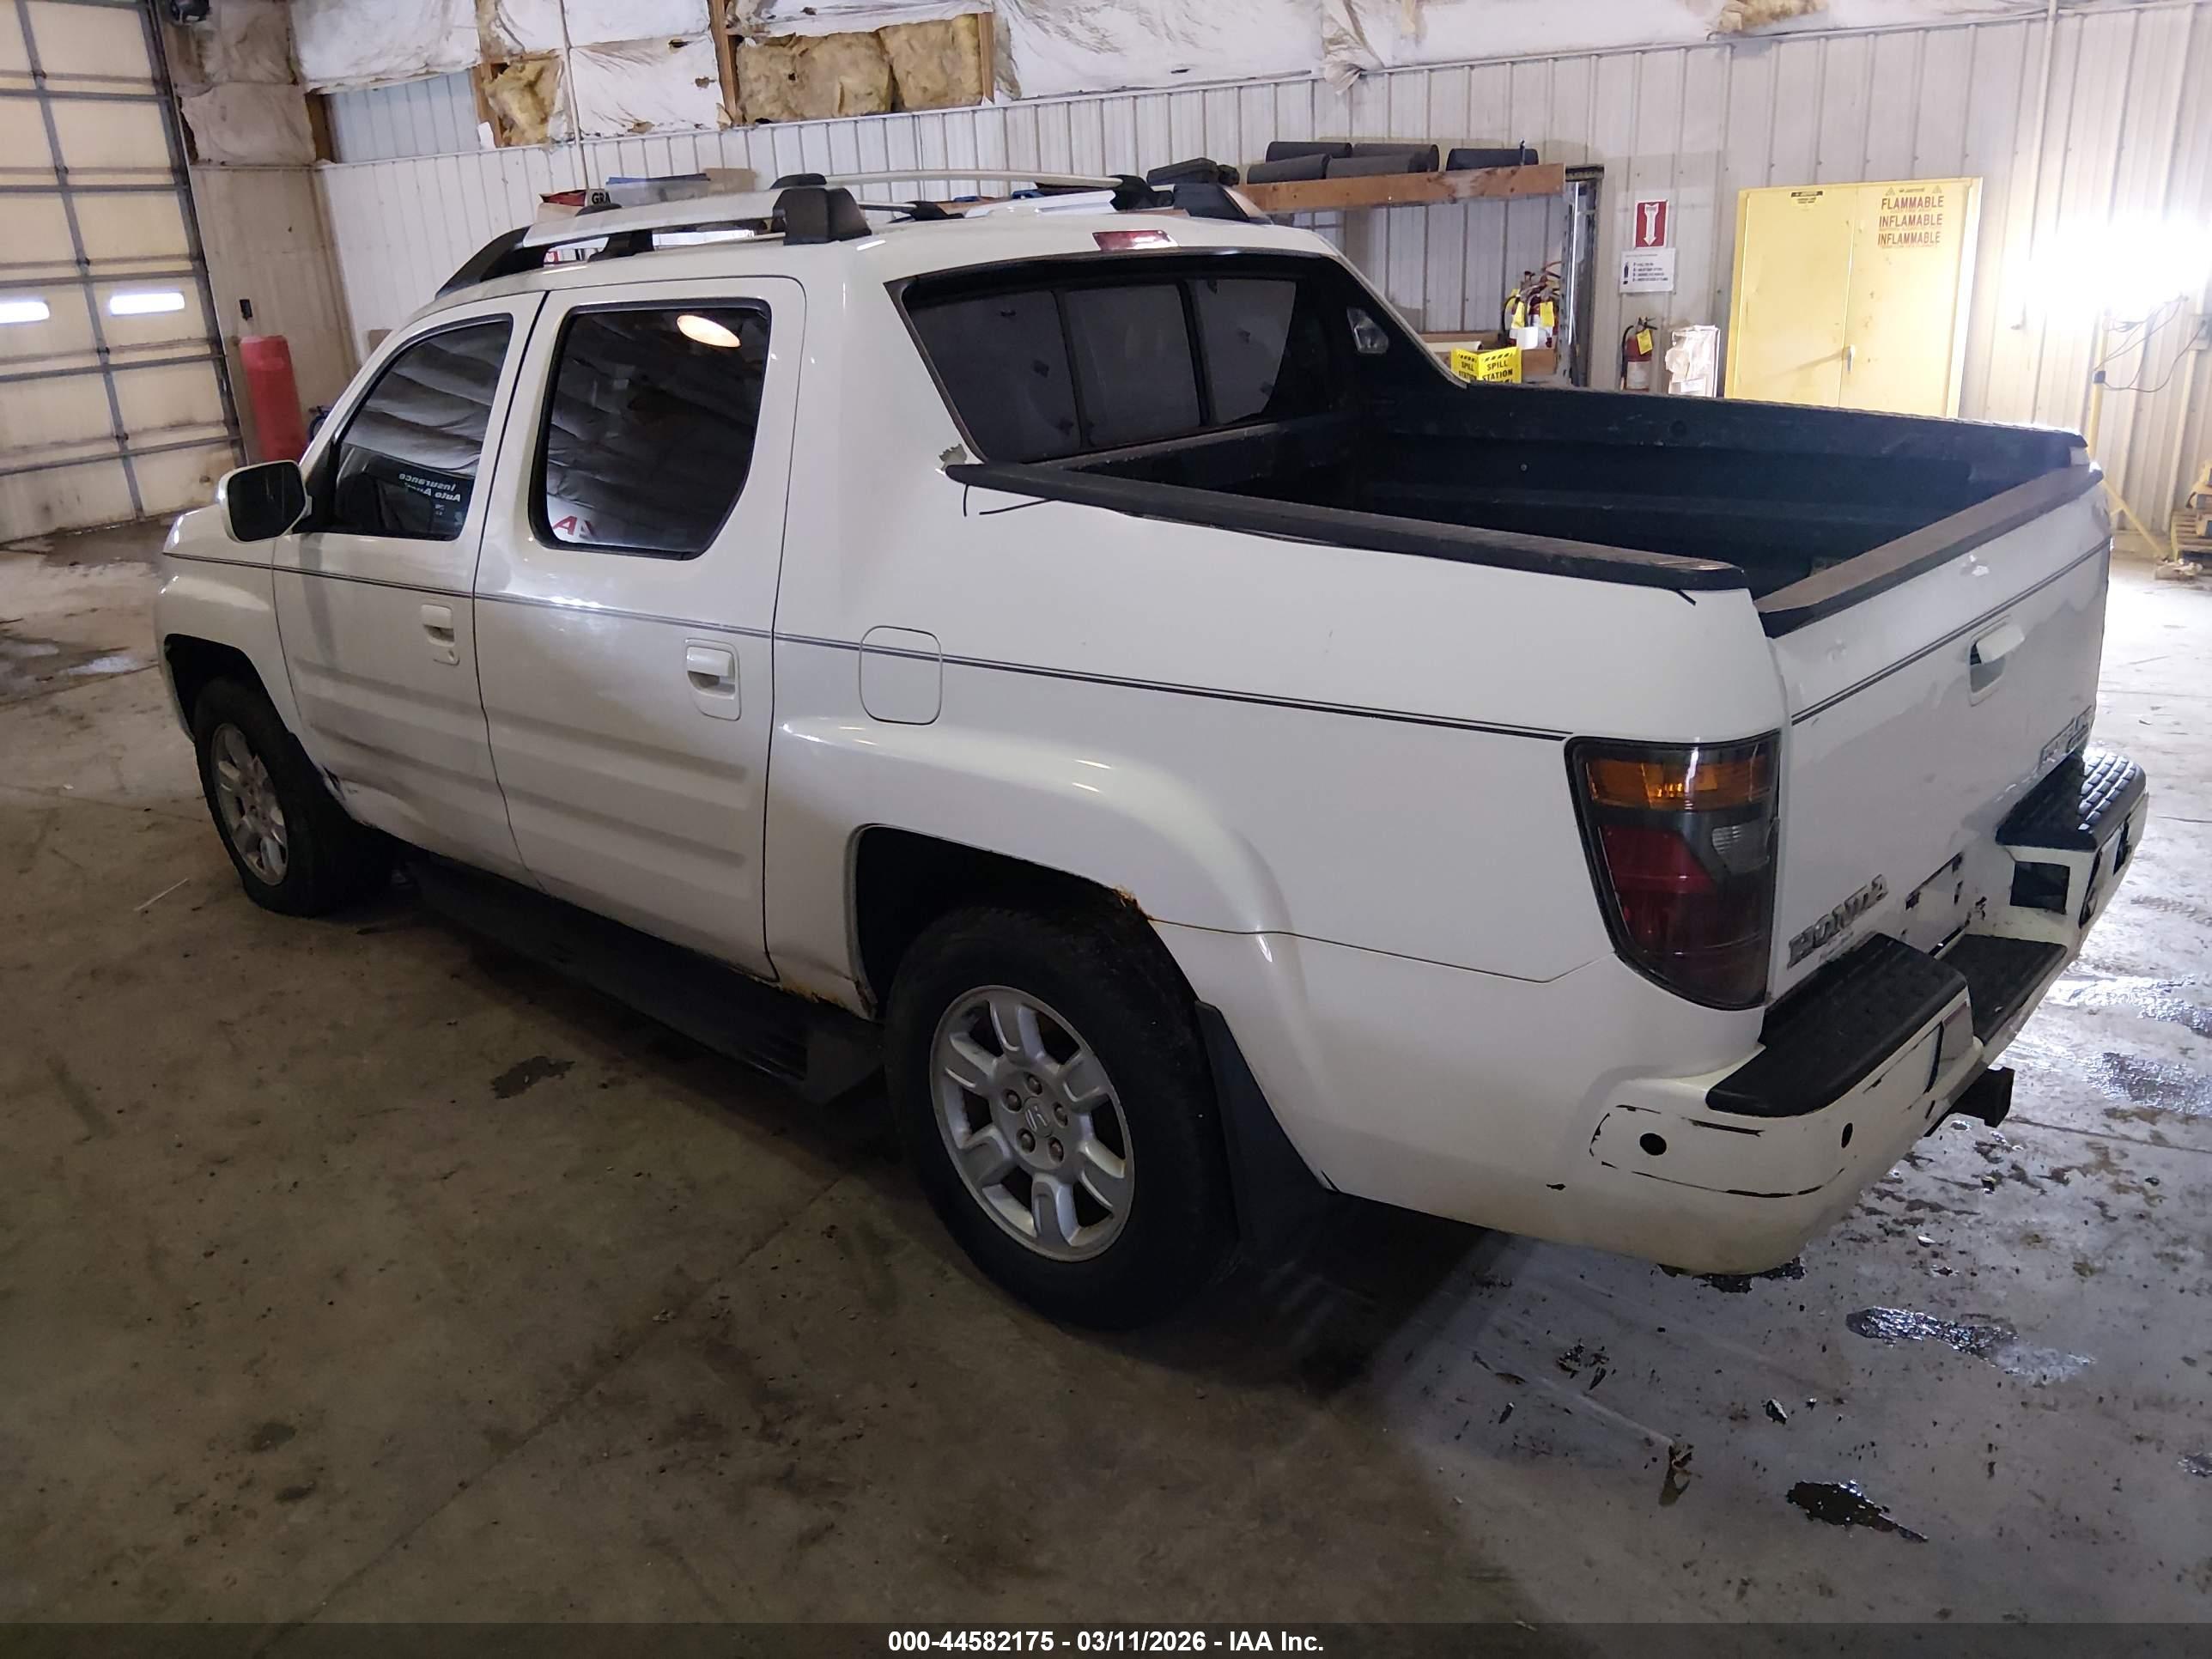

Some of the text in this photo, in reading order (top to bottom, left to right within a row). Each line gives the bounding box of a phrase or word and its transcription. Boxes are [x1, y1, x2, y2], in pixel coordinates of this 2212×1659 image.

[1881, 196, 1944, 210] FLAMMABLE
[1879, 213, 1943, 228] INFLAMABLE
[1877, 231, 1942, 246] INFLAMMABLE
[1486, 360, 1508, 371] SPILL
